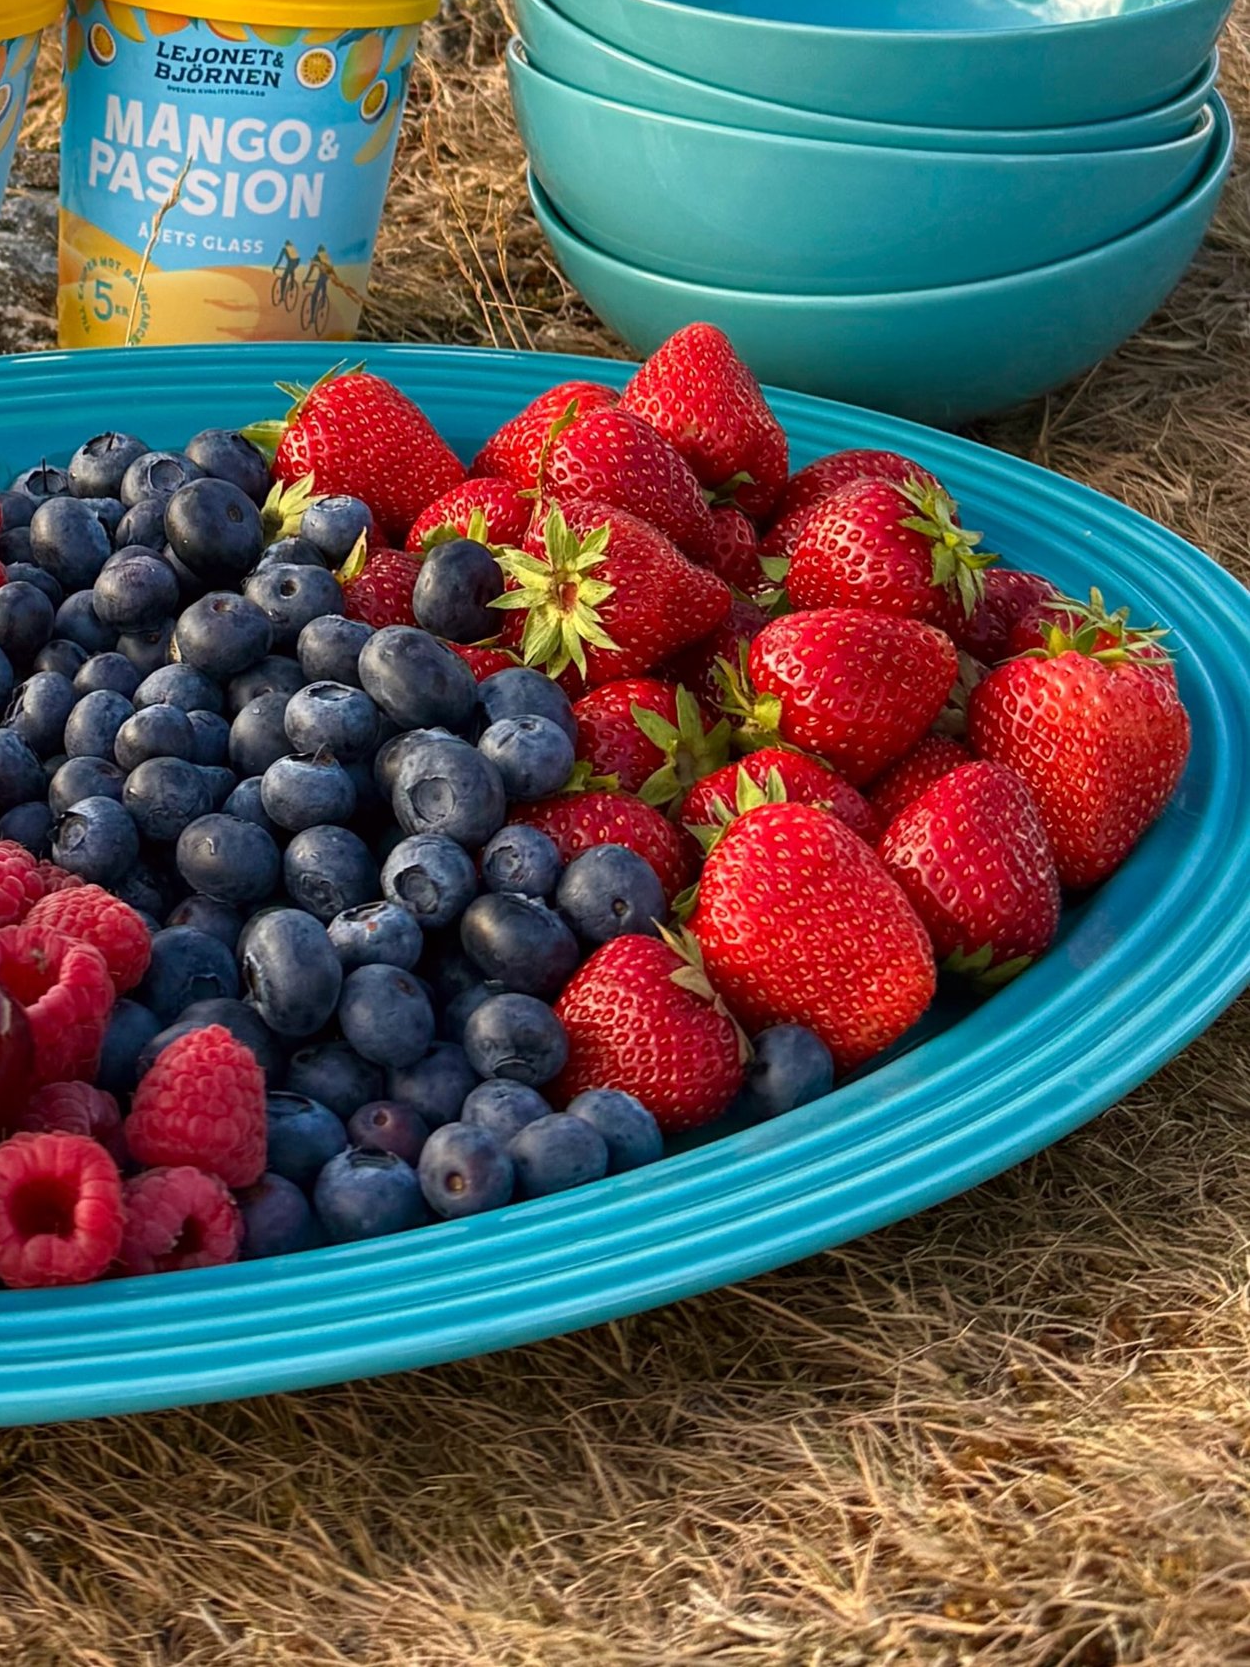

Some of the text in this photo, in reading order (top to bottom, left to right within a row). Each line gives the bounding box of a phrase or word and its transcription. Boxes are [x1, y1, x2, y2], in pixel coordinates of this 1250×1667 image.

[154, 61, 281, 89] BJÖRNEN
[88, 137, 325, 219] PASSION
[137, 221, 264, 254] ÅETS GLASS
[94, 278, 113, 322] 5
